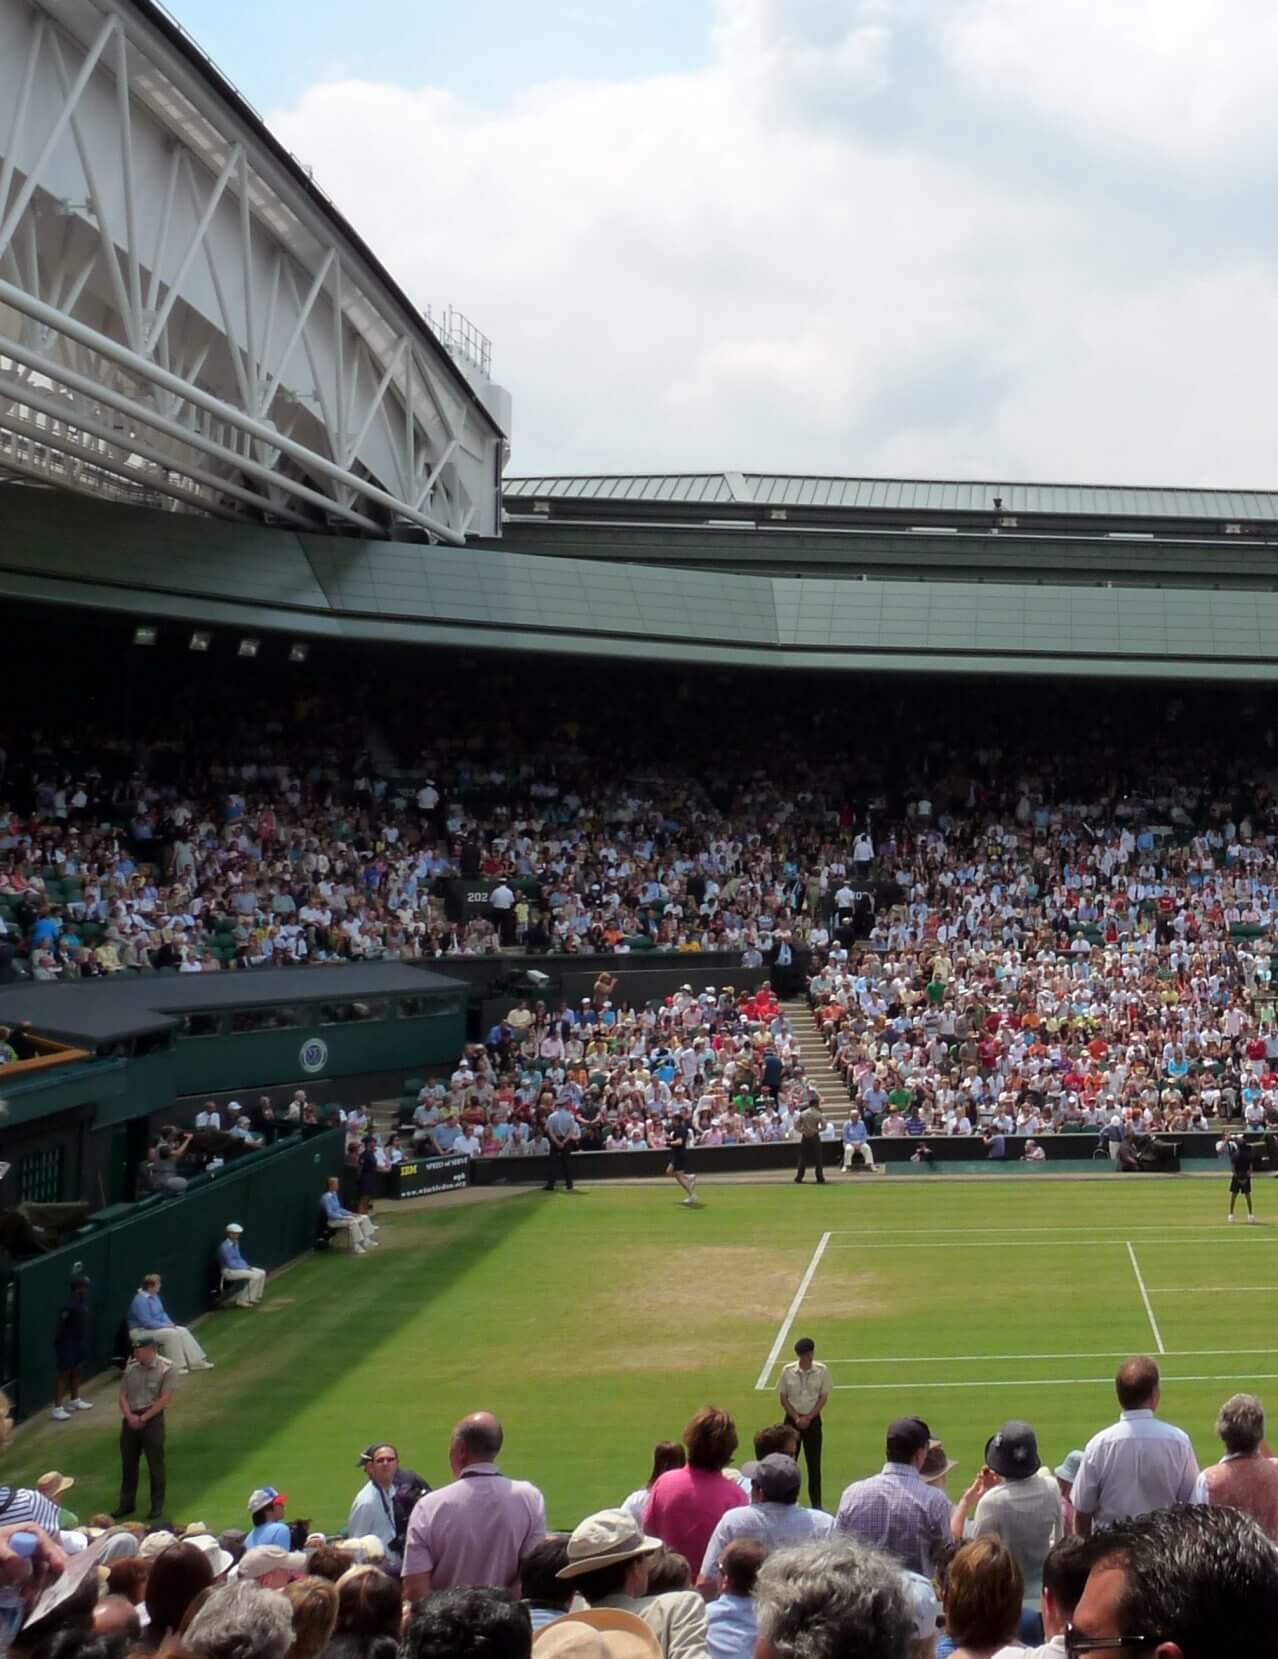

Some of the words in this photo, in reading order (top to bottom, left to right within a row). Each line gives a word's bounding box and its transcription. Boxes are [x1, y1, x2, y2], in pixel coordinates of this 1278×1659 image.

[467, 892, 489, 903] 202
[426, 1161, 443, 1169] SPEED
[452, 1157, 468, 1166] SERVE
[400, 1164, 417, 1176] IBM
[453, 1172, 466, 1181] mph
[400, 1181, 466, 1197] www.wimbledon.org
